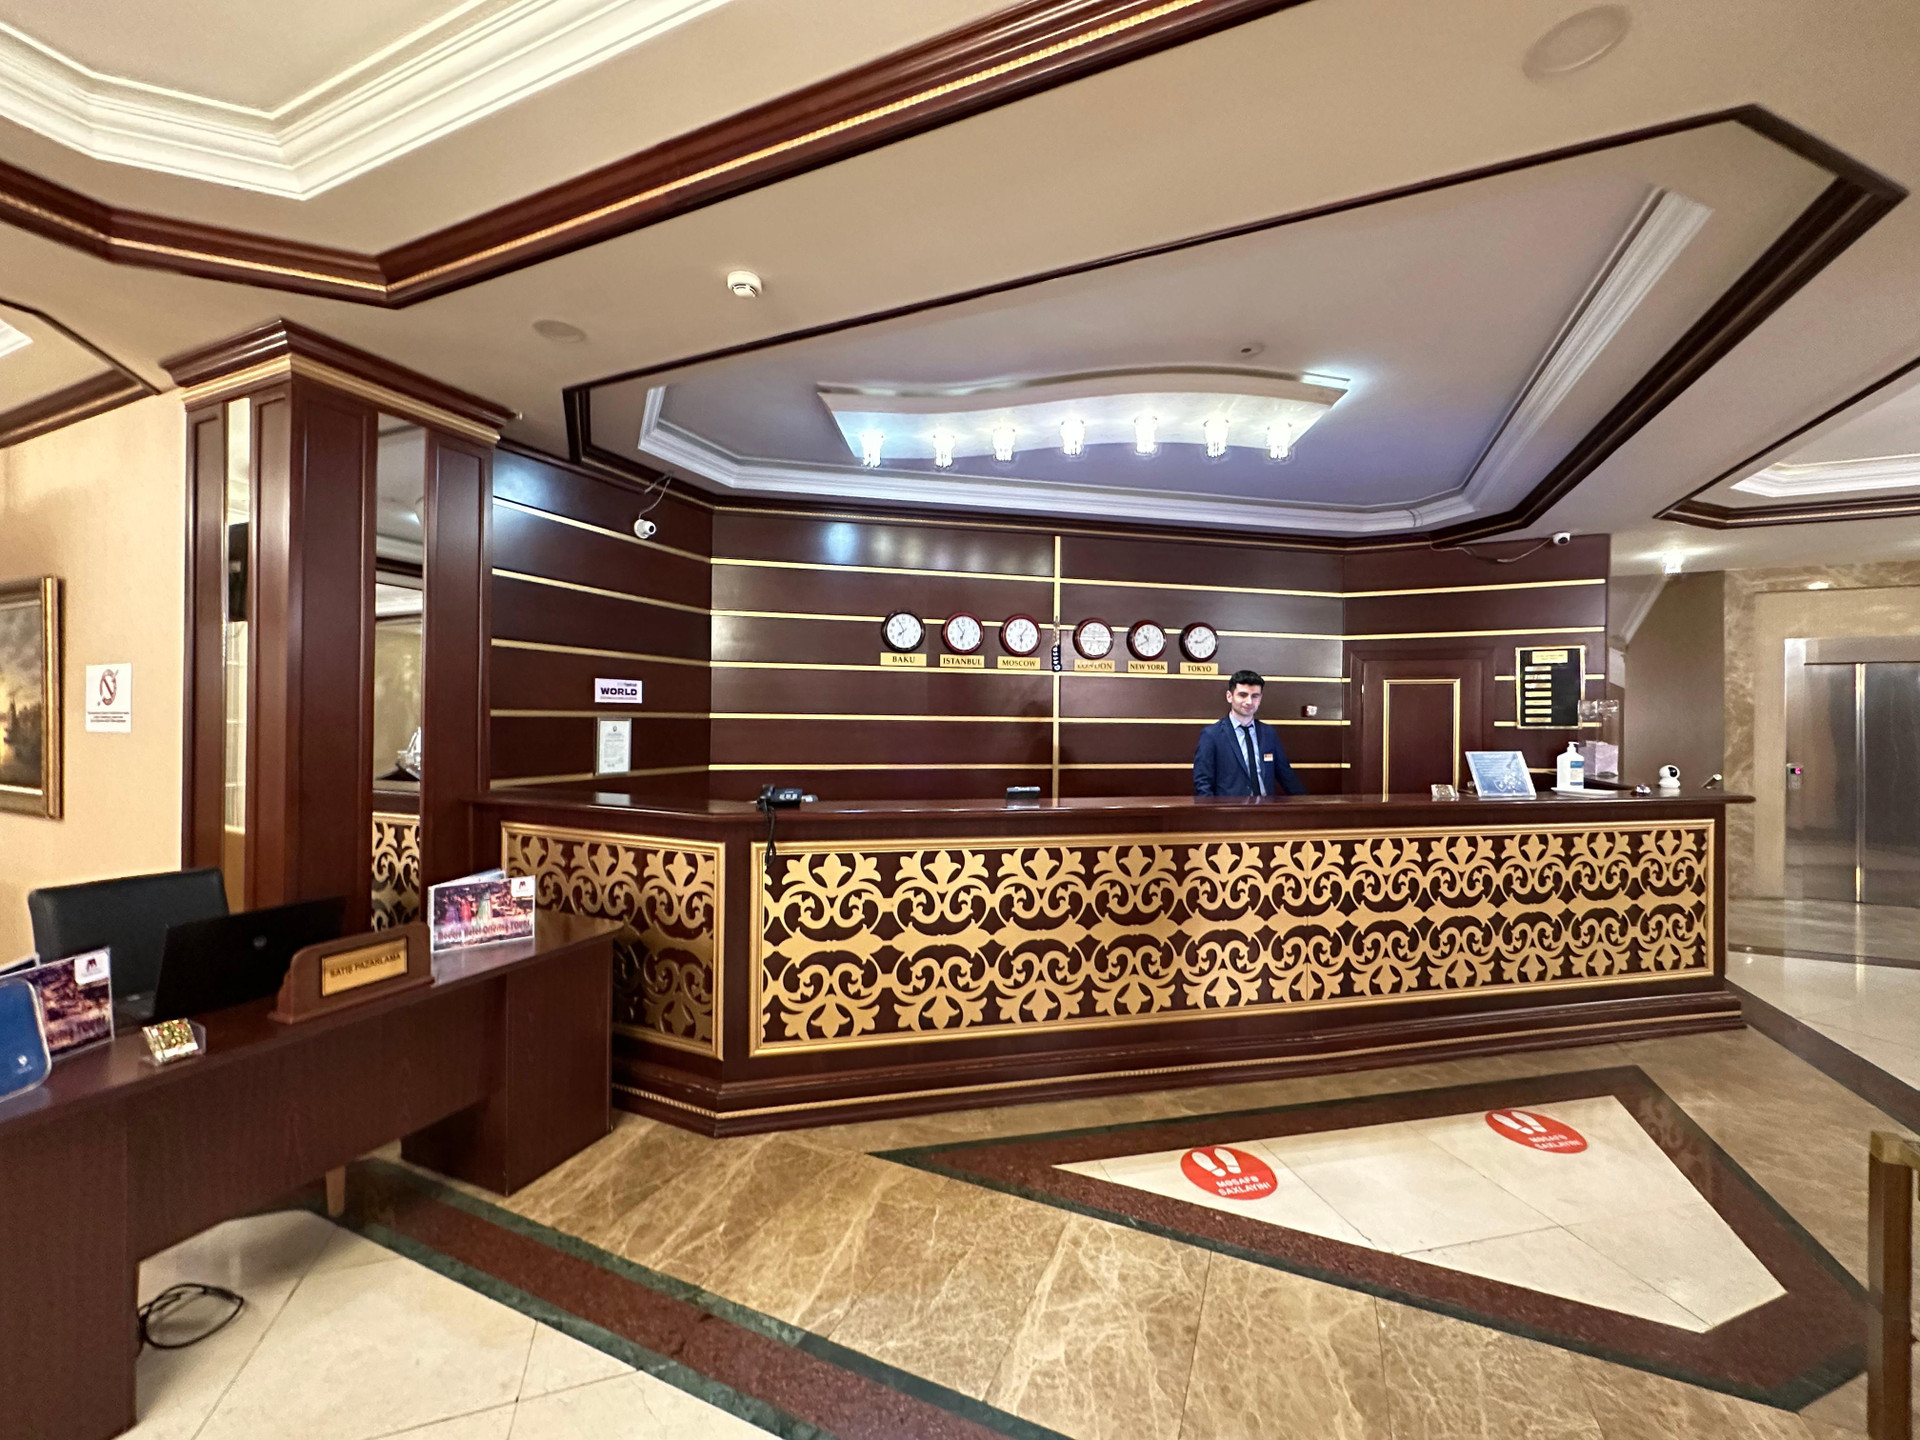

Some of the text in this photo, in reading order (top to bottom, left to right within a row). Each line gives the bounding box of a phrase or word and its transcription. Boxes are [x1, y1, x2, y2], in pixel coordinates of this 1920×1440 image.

[892, 655, 915, 663] BAKU
[943, 657, 983, 666] ISTANBUL
[1002, 659, 1037, 667] MOSCOW
[1147, 663, 1166, 671] YORK
[600, 687, 638, 696] WORLD
